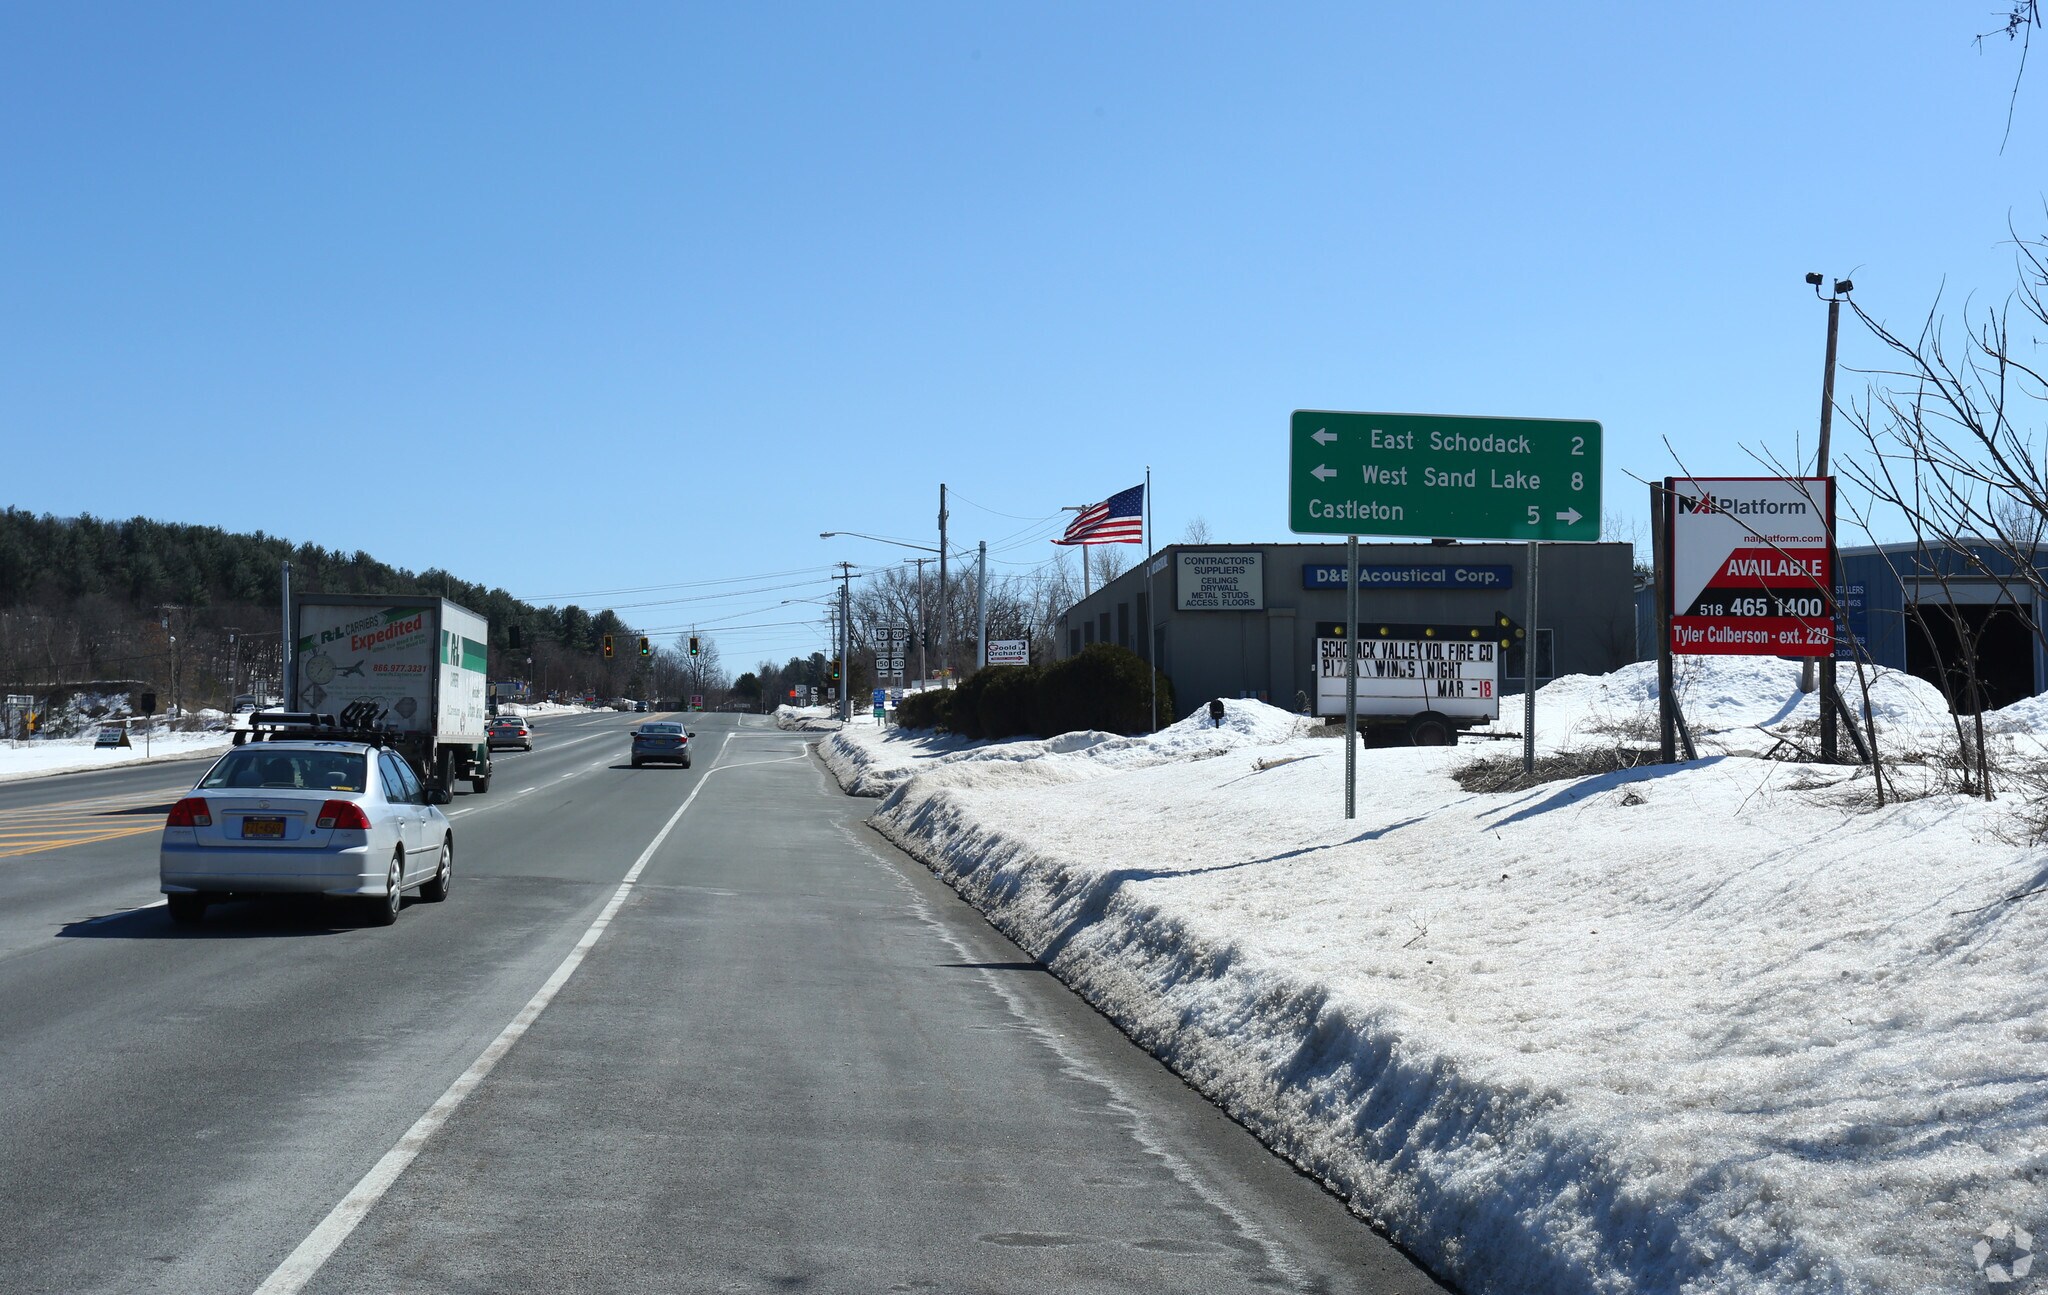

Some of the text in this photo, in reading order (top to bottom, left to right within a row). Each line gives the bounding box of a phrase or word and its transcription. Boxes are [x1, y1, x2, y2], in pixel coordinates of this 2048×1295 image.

[1371, 429, 1584, 456] East Schodack 2
[1363, 465, 1584, 491] West Sand Lake 8
[1309, 499, 1541, 525] Castleton 5
[1720, 498, 1806, 515] Platform
[1743, 534, 1823, 544] naiplatform.com
[1184, 556, 1255, 565] CONTRACTORS
[1727, 559, 1822, 577] AVAILABLE
[1194, 566, 1246, 575] SUPPLIERS
[1359, 568, 1446, 583] Acoustical
[1454, 569, 1499, 585] Corp.
[1700, 603, 1723, 616] 518
[1730, 598, 1767, 617] 465
[1775, 598, 1822, 617] 1400
[345, 615, 379, 636] CARRIERS
[351, 613, 423, 652] Expedited
[880, 630, 885, 638] 9
[893, 630, 902, 638] 20
[1673, 625, 1704, 647] Tyler
[1707, 625, 1768, 644] Culberson
[1779, 629, 1803, 644] ext.
[1321, 640, 1376, 659] SCHOACK
[1382, 641, 1423, 660] VALLEY
[1426, 642, 1445, 660] VOL
[1448, 643, 1474, 661] FIRE
[877, 660, 889, 668] 150
[893, 660, 904, 668] 150
[1427, 661, 1463, 679] NIGHT
[1437, 680, 1464, 698] MAR
